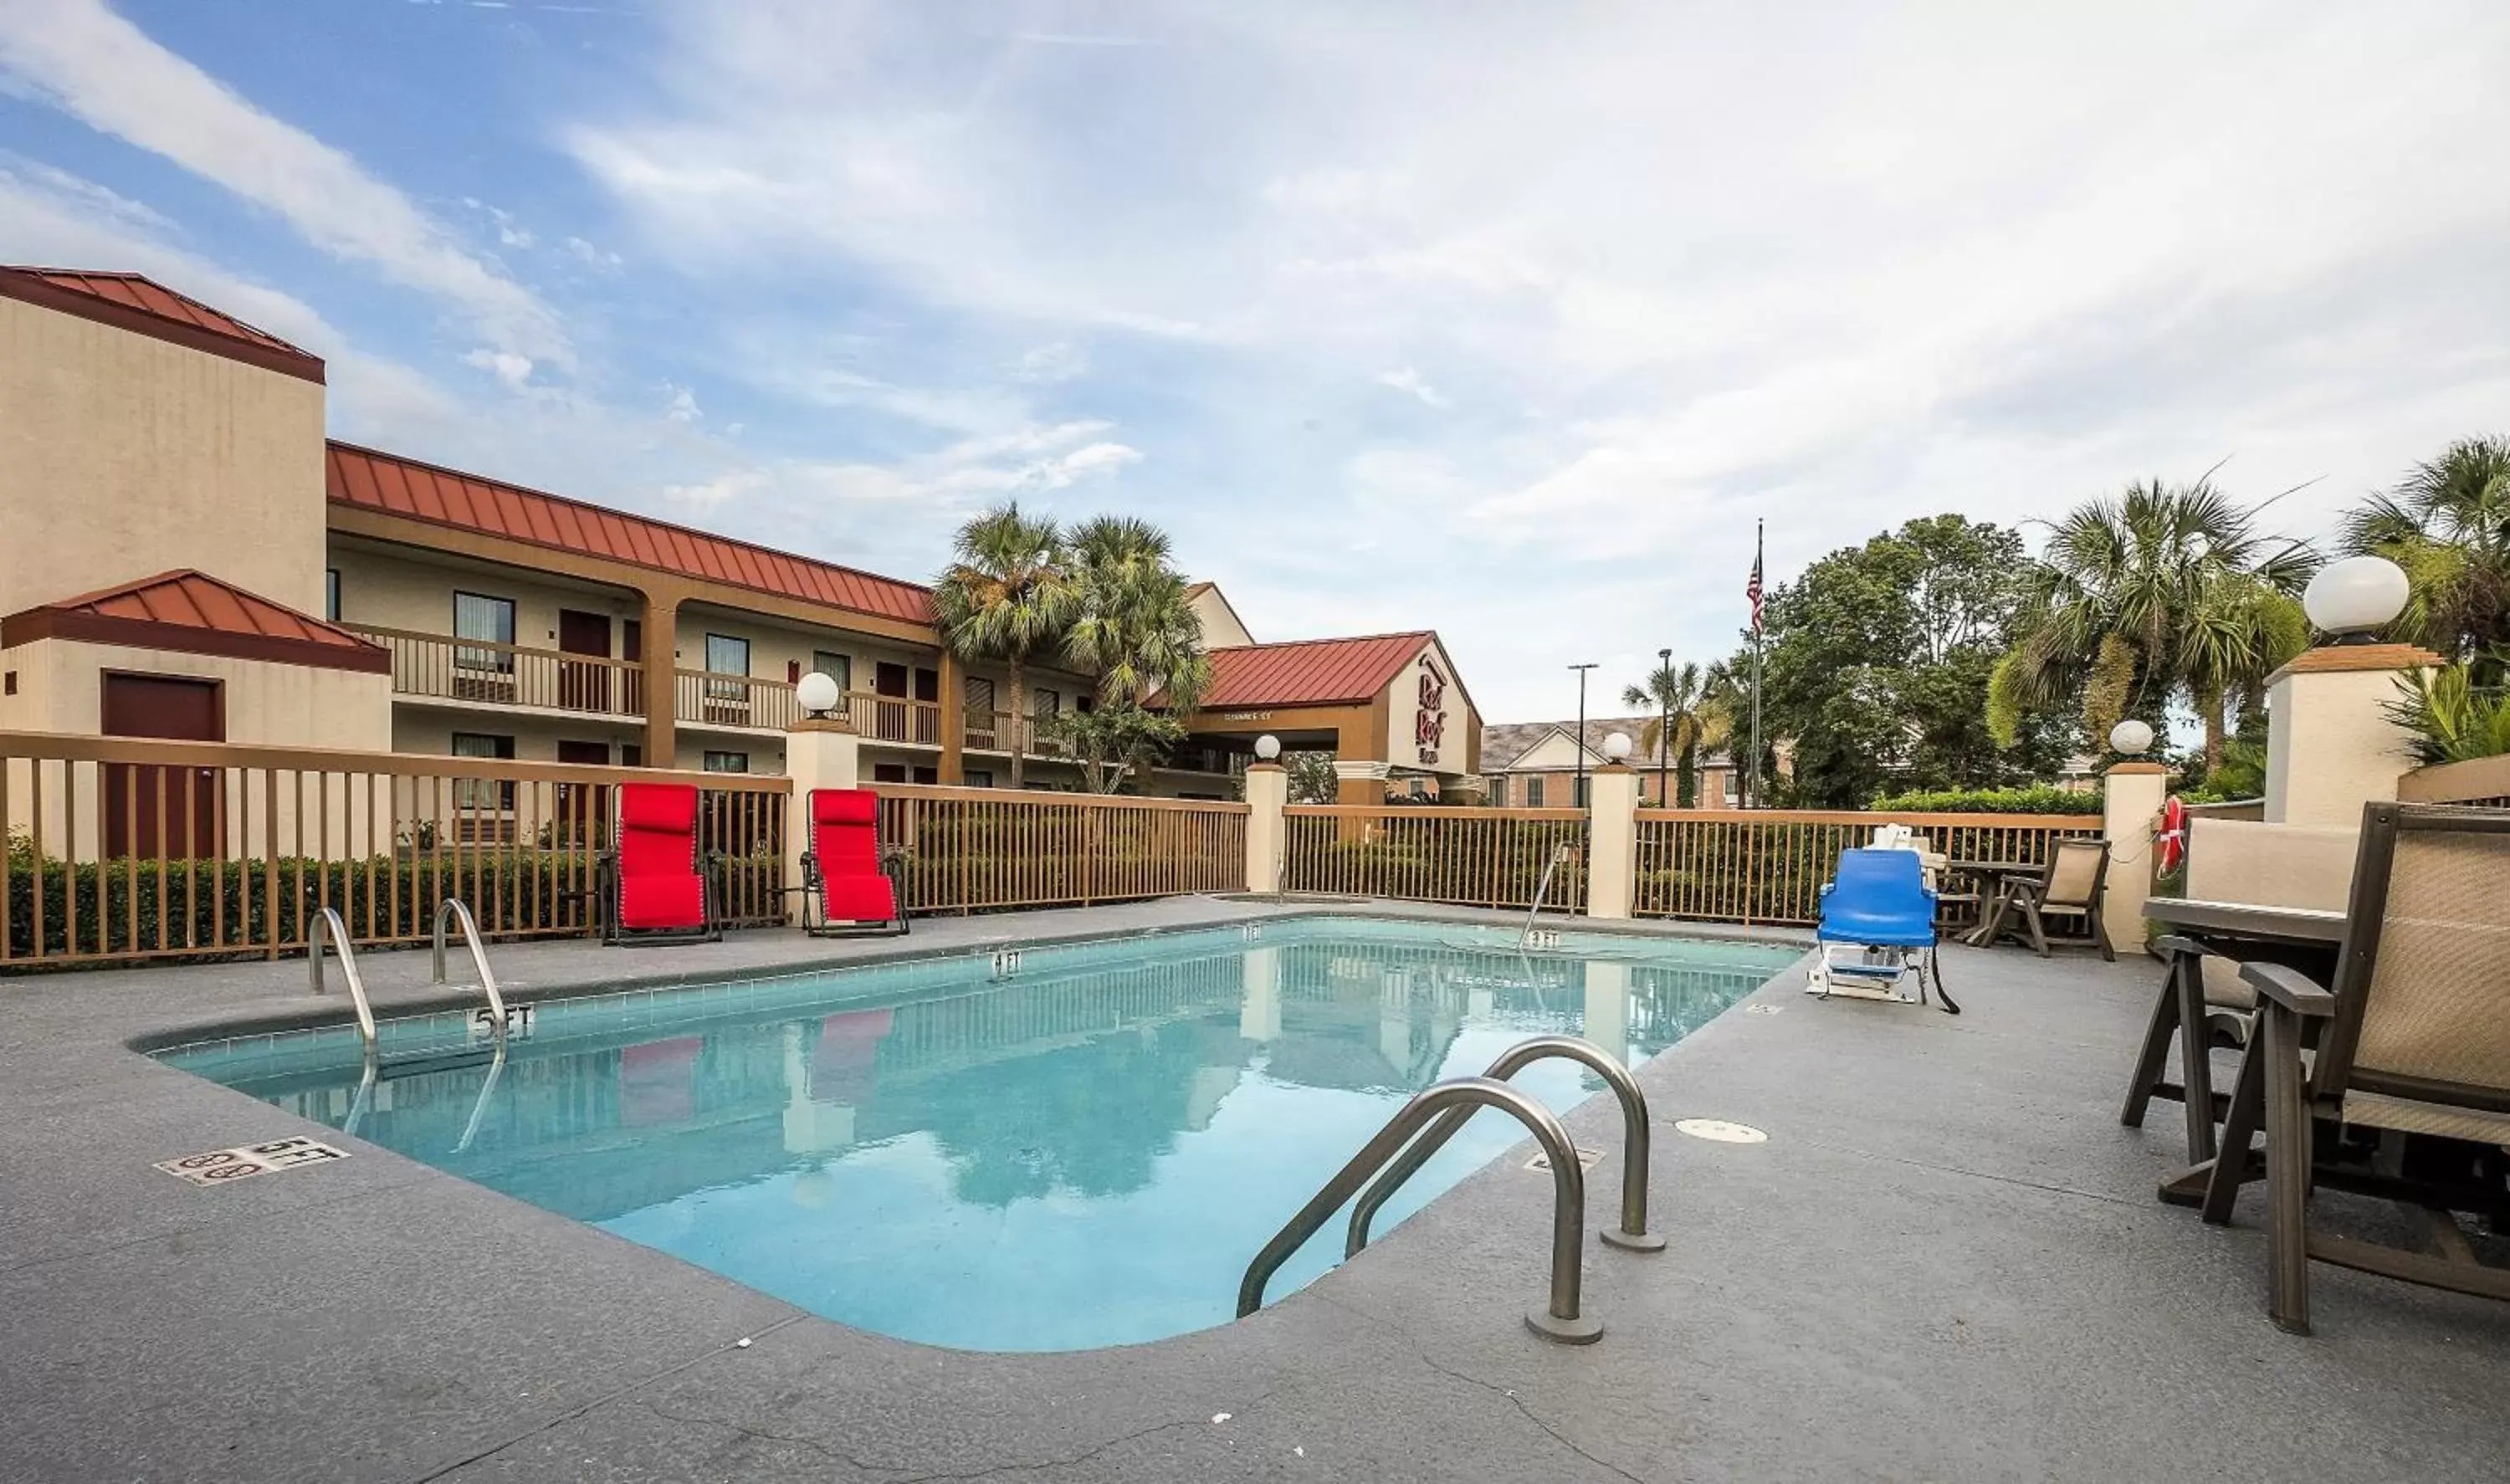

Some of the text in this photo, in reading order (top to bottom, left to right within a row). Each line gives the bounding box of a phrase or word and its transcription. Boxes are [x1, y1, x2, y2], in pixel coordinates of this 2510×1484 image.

[1419, 674, 1442, 710] Red
[1416, 709, 1447, 748] Roof
[1544, 933, 1559, 948] FT
[1007, 951, 1019, 965] FT
[505, 1006, 530, 1029] FT
[268, 1147, 340, 1165] FT
